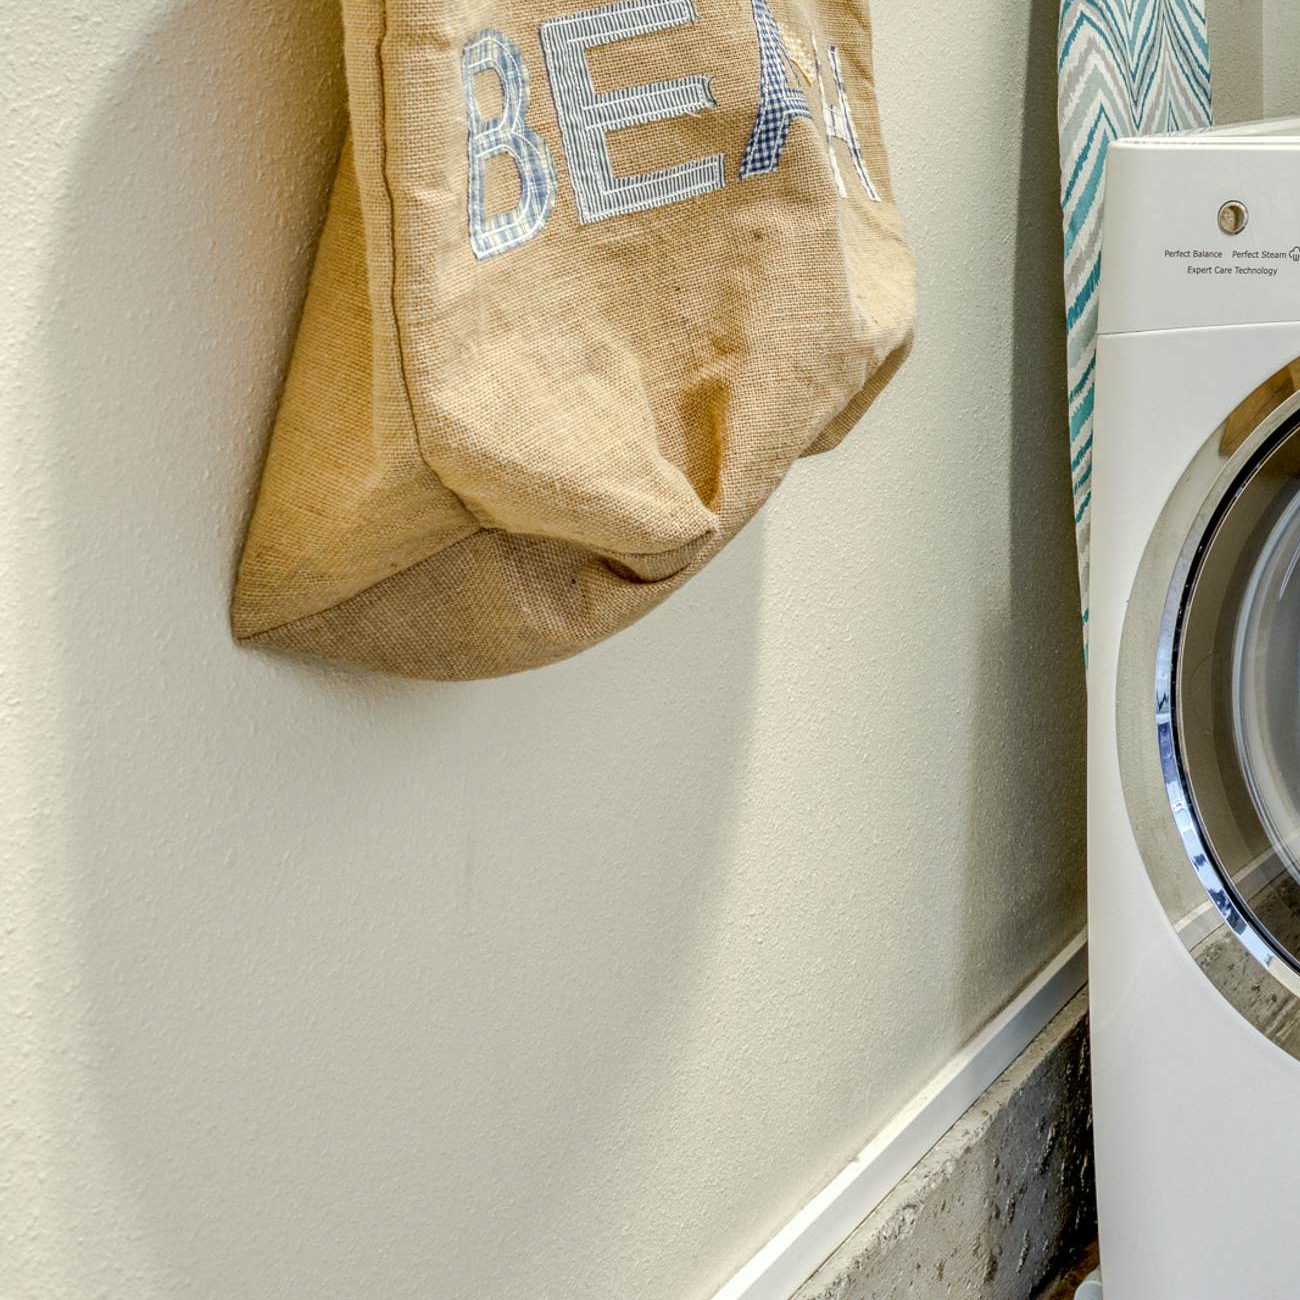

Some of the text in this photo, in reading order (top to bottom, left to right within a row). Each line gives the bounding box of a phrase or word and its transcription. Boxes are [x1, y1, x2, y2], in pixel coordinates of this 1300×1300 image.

[1164, 249, 1223, 258] Perfect Balance
[1232, 250, 1287, 259] Perfect Steam
[1187, 266, 1278, 276] Expert Care Technology
